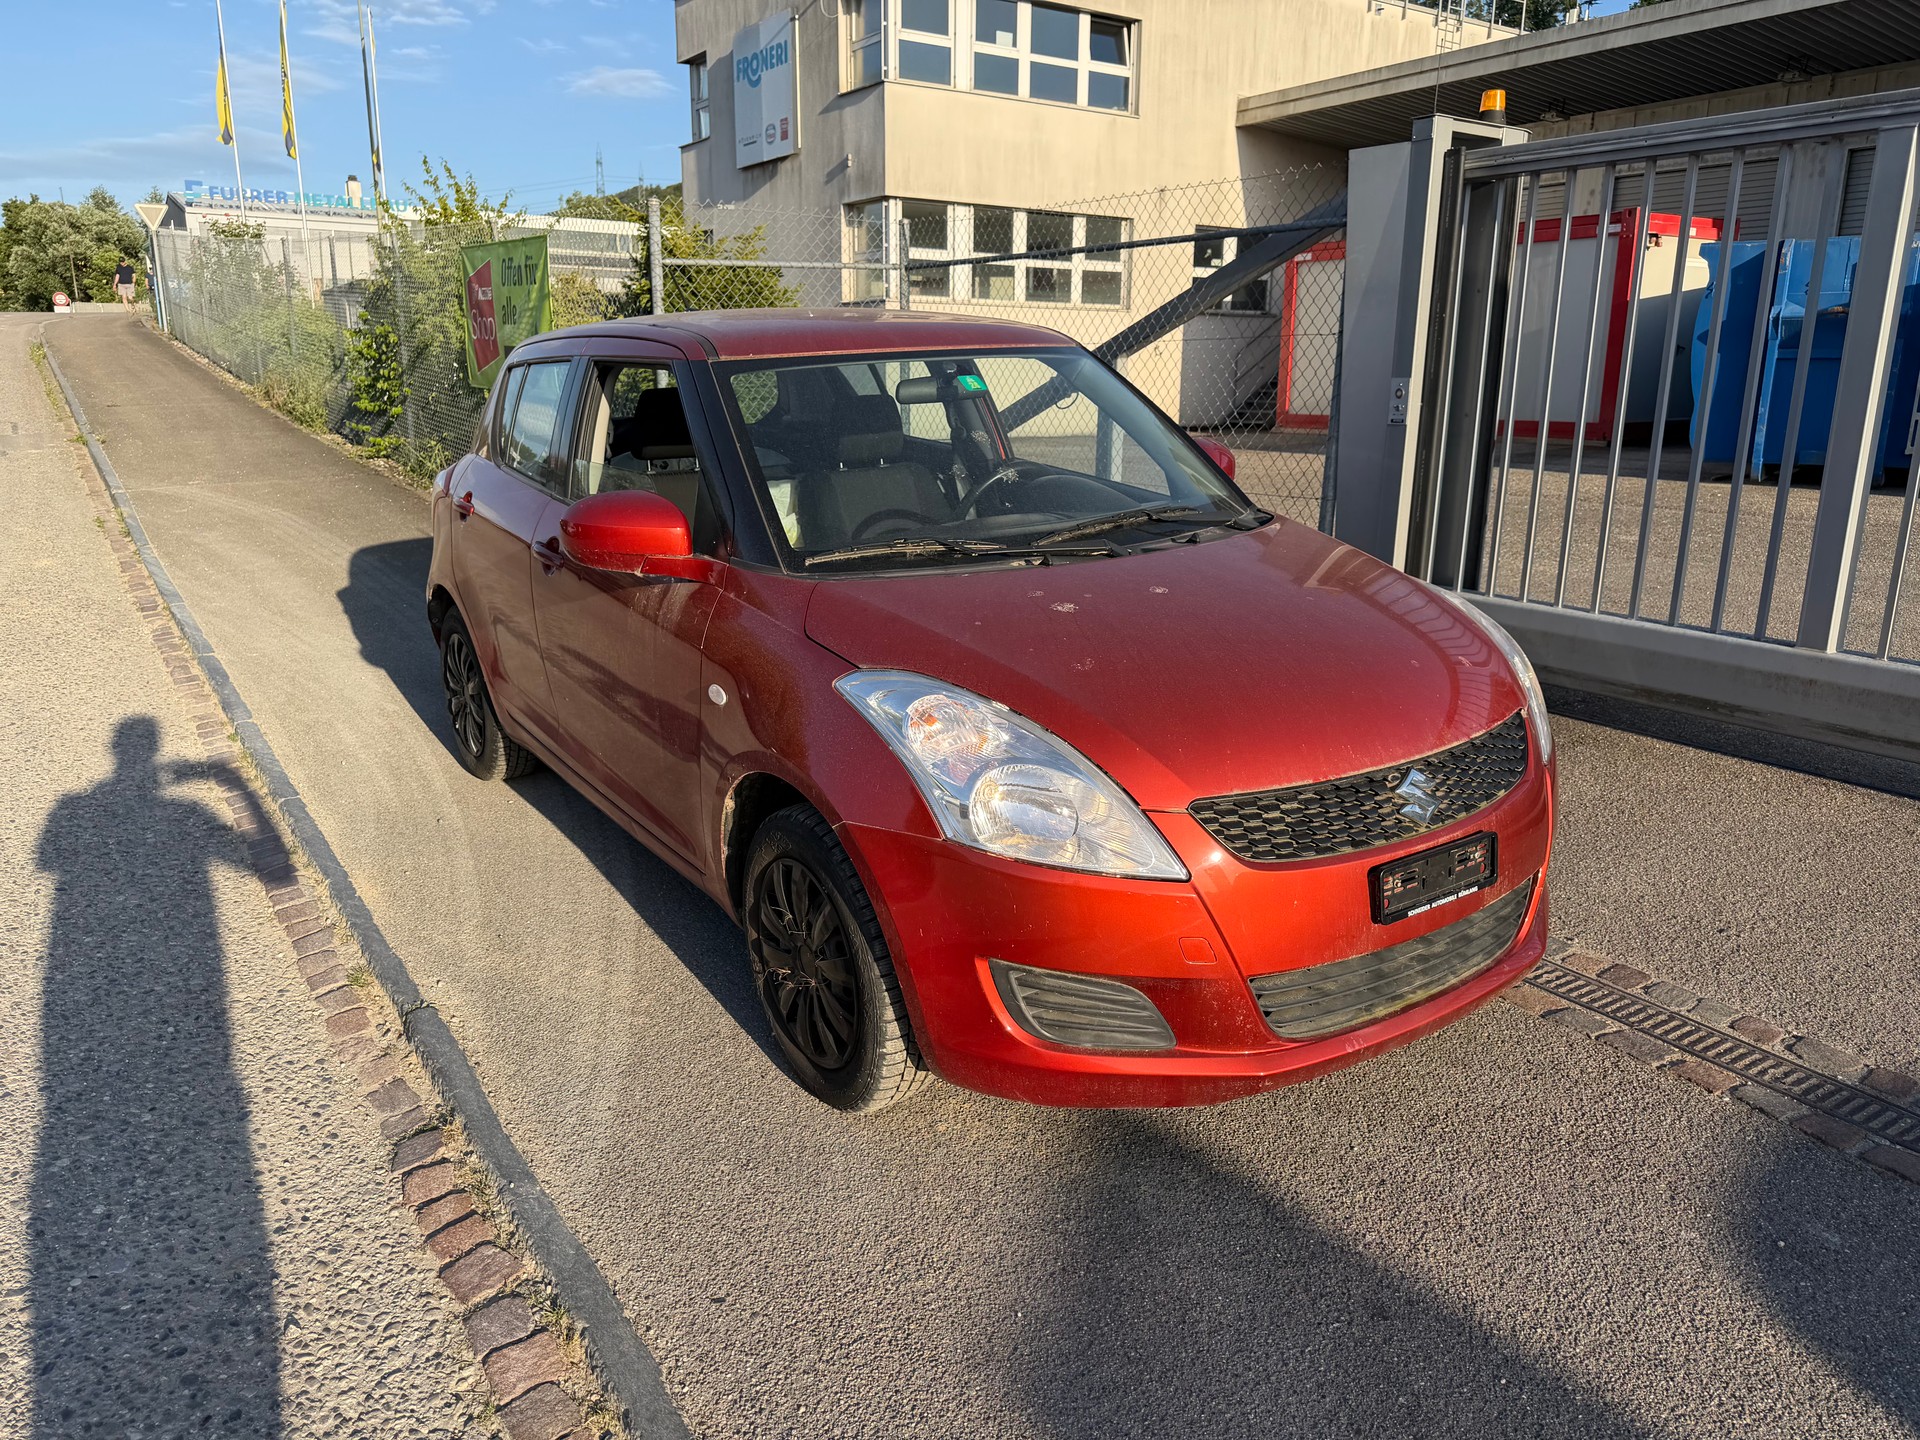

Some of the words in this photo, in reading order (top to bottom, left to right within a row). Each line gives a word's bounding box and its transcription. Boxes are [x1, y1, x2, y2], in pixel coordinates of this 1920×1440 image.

[736, 39, 788, 88] FRONERI
[208, 185, 289, 204] FURRER
[501, 257, 523, 287] Offen
[501, 296, 518, 325] alle
[471, 309, 496, 351] Shop
